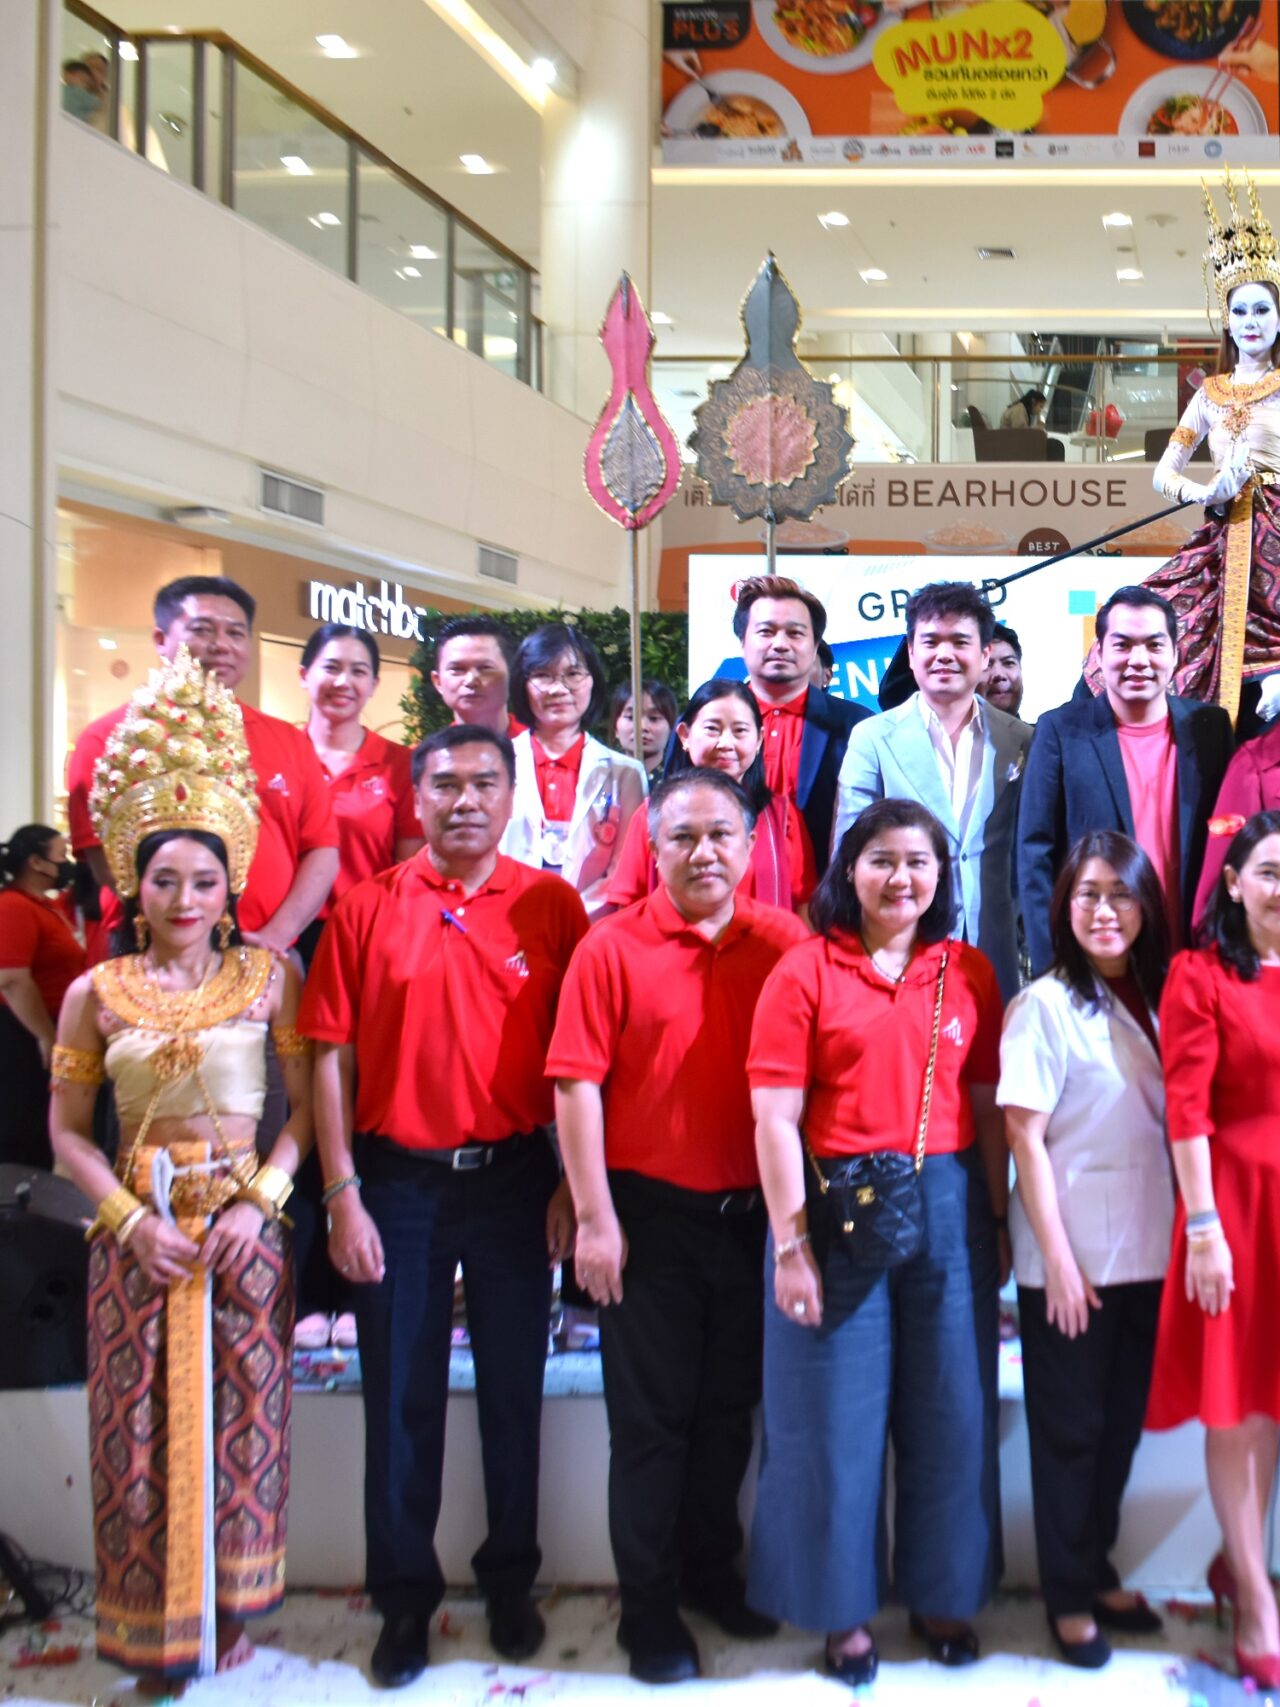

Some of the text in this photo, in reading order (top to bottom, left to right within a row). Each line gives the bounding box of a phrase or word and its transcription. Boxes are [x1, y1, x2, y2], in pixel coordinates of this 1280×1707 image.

[673, 18, 740, 41] PLUS
[894, 28, 1033, 77] MUNx2
[887, 479, 1127, 507] BEARHOUSE
[1028, 541, 1061, 551] BEST
[858, 578, 1007, 621] GRD
